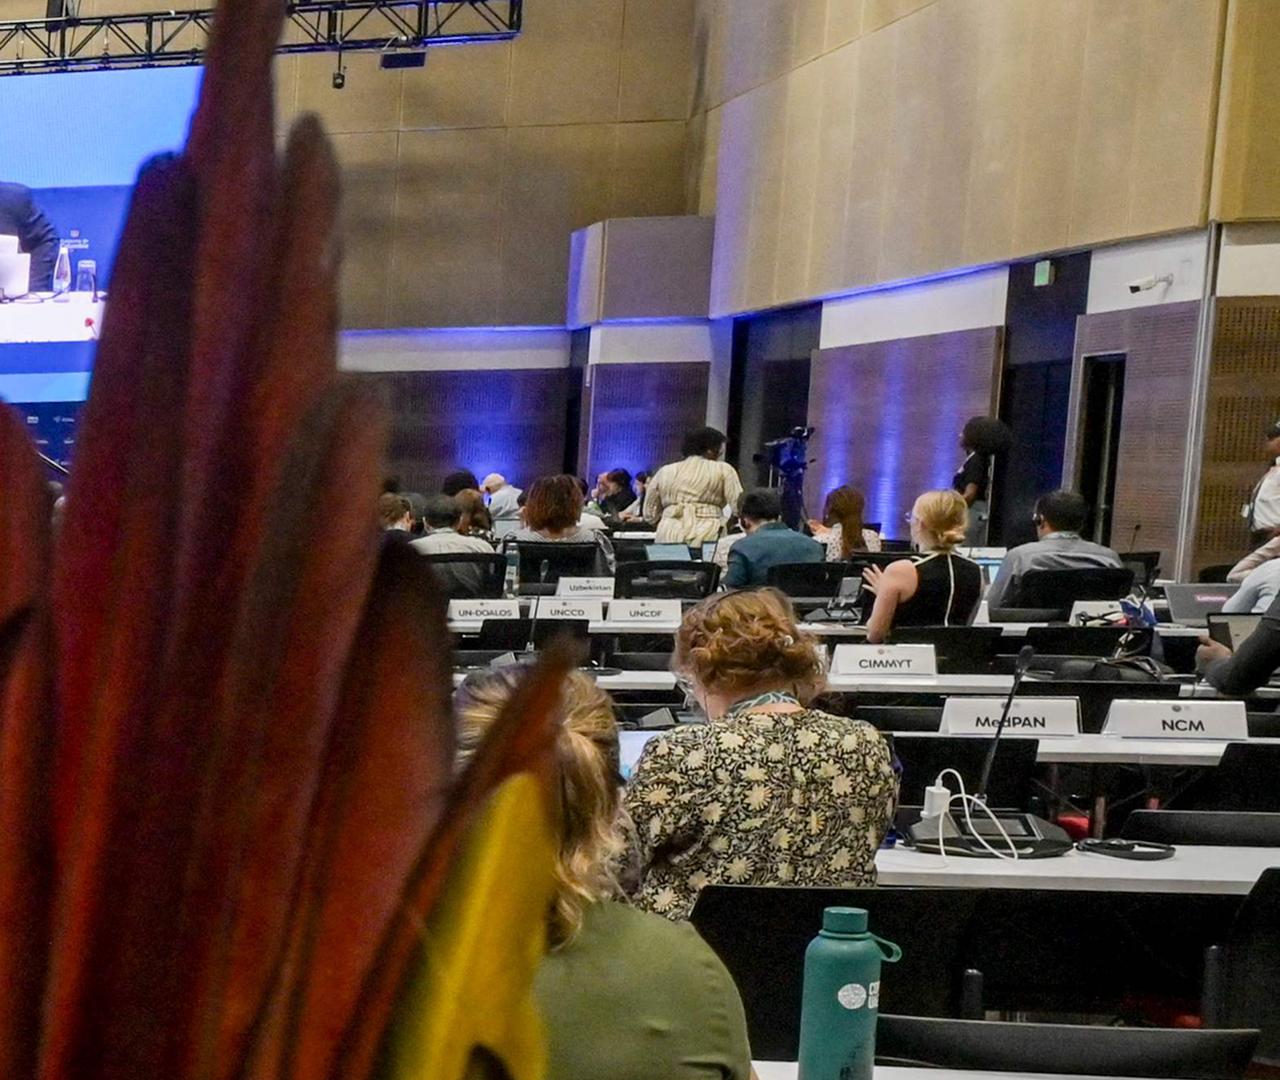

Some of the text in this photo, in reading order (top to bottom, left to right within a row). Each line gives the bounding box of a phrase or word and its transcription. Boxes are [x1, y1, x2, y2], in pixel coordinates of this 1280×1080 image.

[858, 659, 913, 669] CIMMYT
[975, 716, 1046, 729] MedPAN
[1161, 719, 1205, 732] NCM
